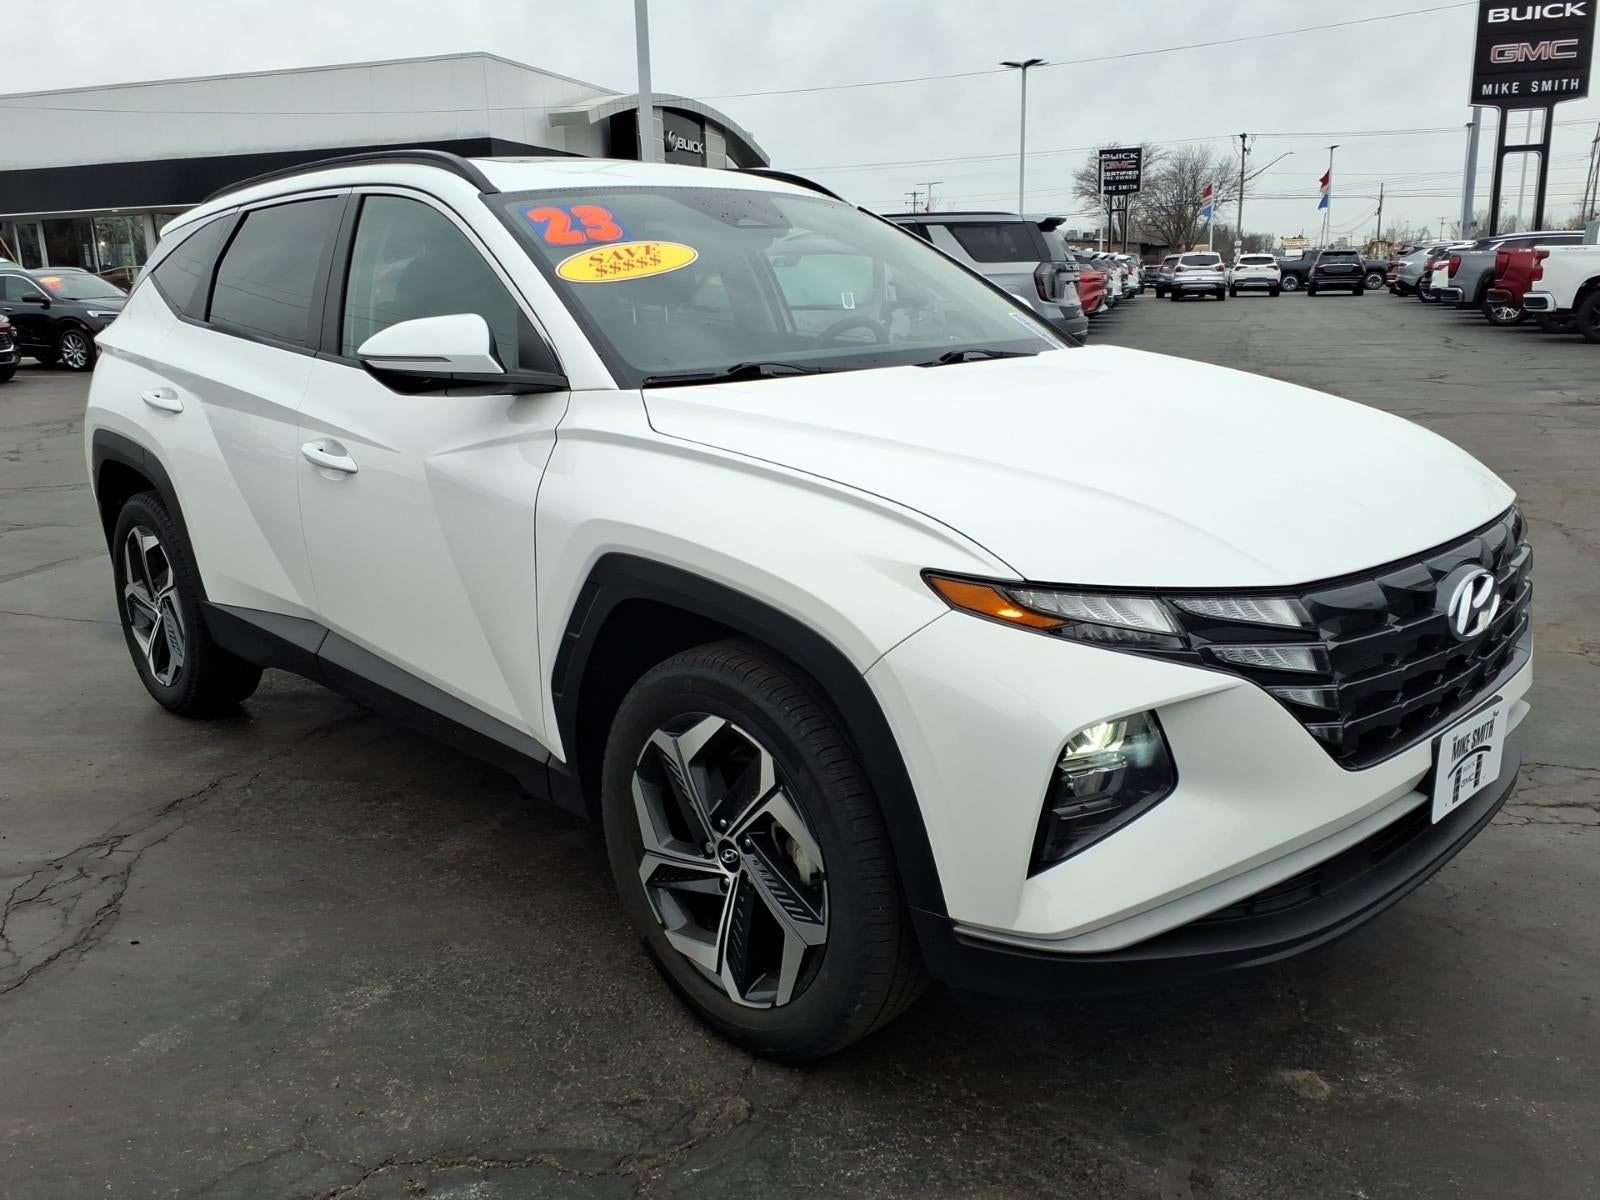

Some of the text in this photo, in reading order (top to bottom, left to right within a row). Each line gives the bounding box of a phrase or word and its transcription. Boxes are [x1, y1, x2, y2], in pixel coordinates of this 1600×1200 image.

[1488, 2, 1587, 23] BUICK
[1490, 38, 1579, 64] GMC
[1482, 78, 1580, 95] MIKE SMITH
[677, 137, 704, 154] BUICK
[1104, 160, 1136, 169] GMC
[527, 205, 624, 246] 23
[589, 243, 660, 267] SAVE
[1451, 718, 1495, 763] MIKE SMITH
